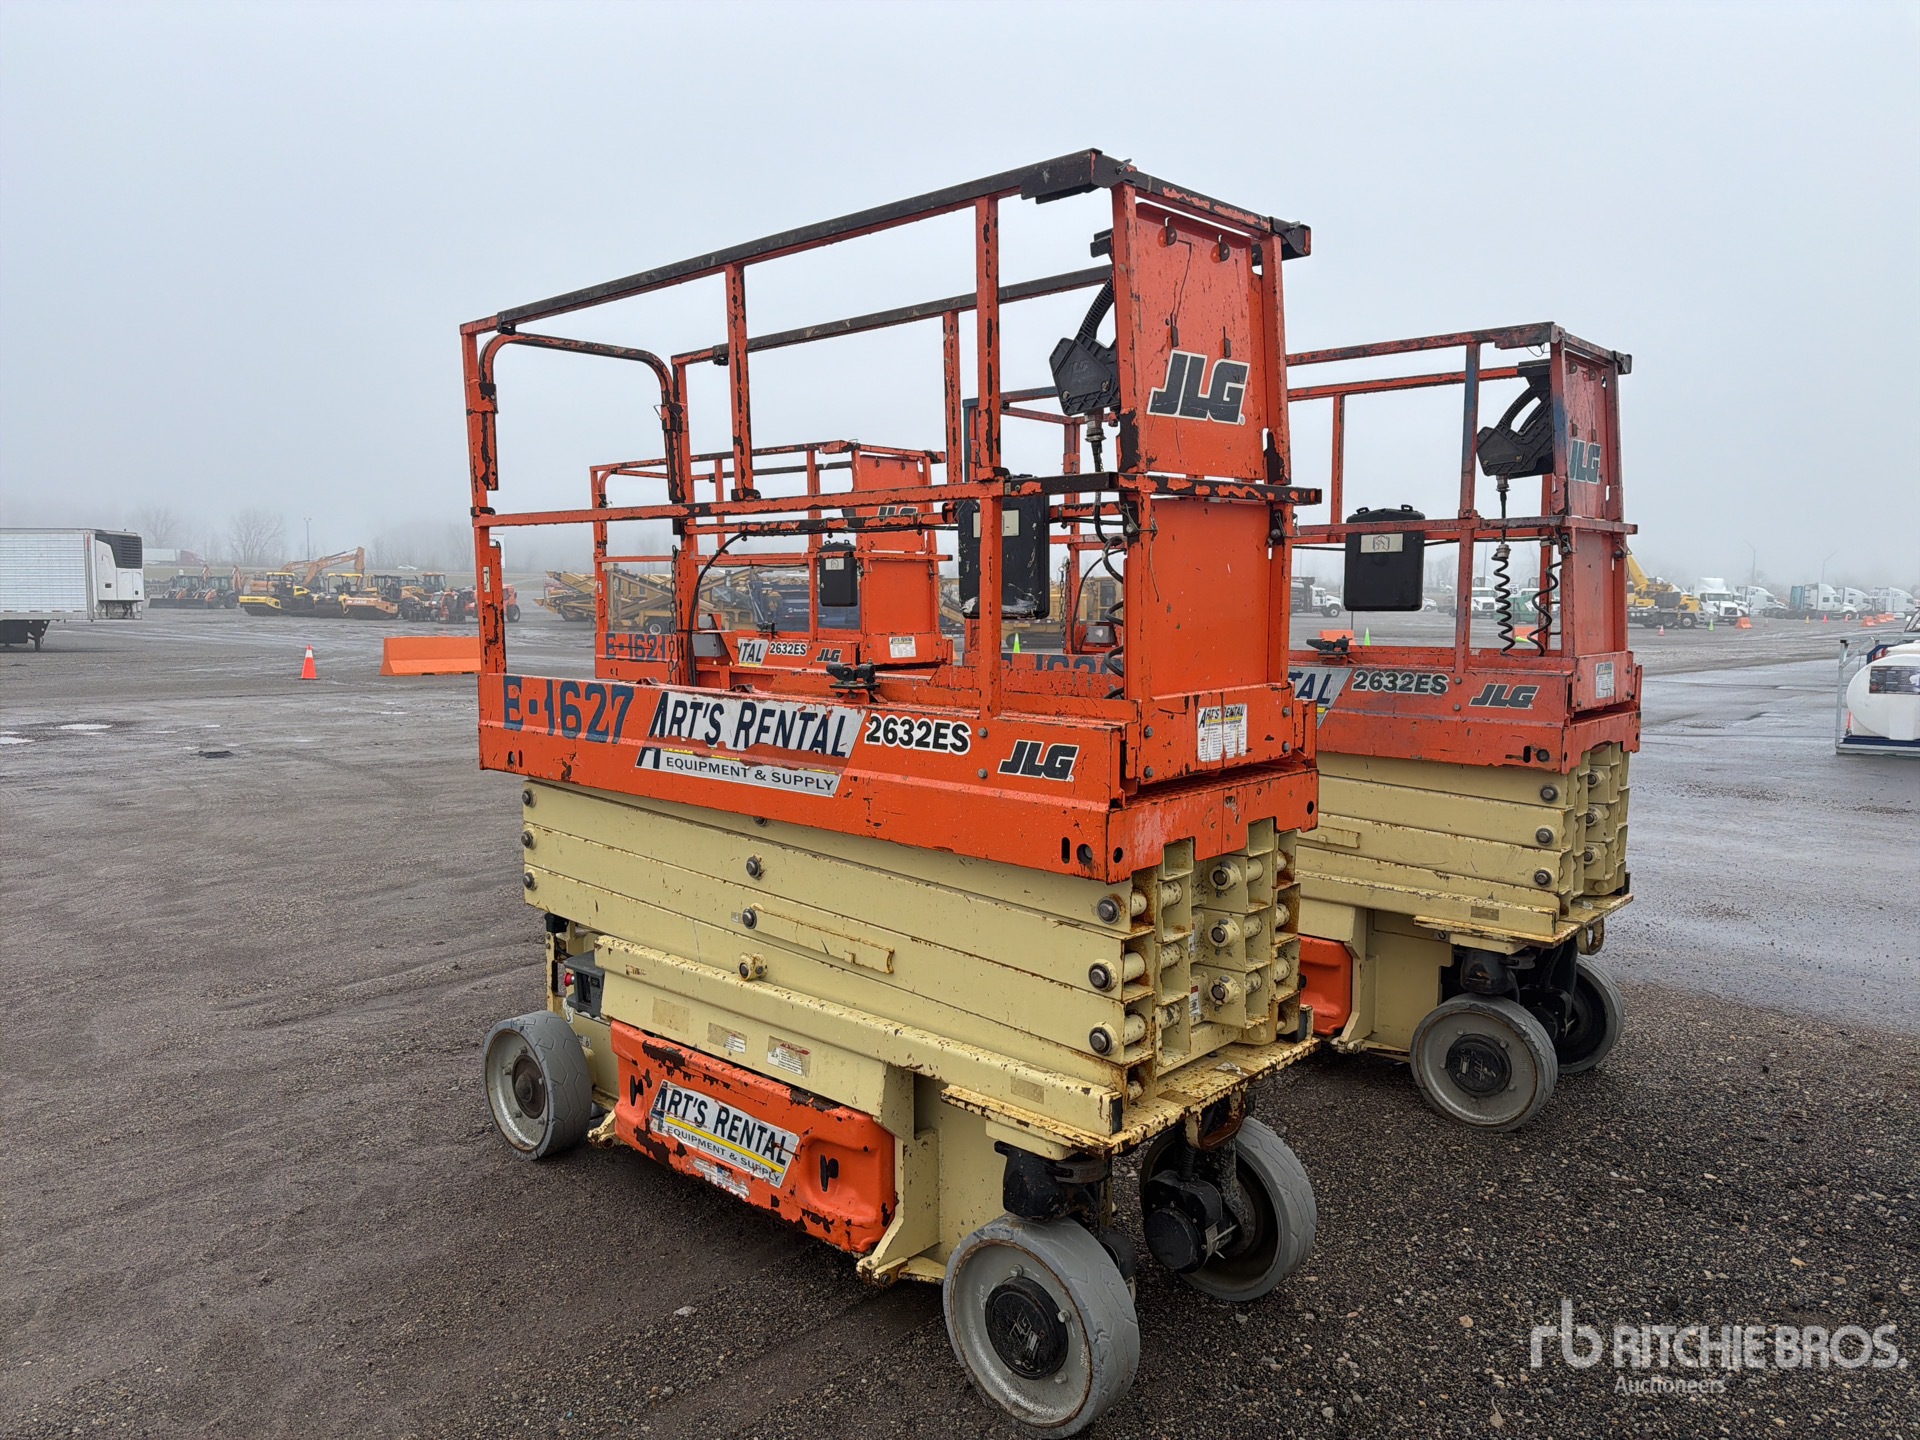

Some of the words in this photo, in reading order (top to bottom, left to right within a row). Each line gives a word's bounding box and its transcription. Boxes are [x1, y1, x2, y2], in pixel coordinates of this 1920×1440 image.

[1148, 350, 1249, 424] JLG
[1569, 439, 1601, 484] JLG
[606, 633, 666, 659] E-1621
[738, 642, 763, 663] TAL
[769, 642, 806, 656] 2632ES
[816, 648, 842, 662] JLG
[1351, 672, 1448, 694] 2632ES
[1470, 684, 1539, 708] JLG
[503, 675, 634, 744] E-1627
[732, 701, 848, 758] RENTAL
[866, 714, 971, 753] 2632ES
[666, 755, 750, 780] EQUIPMENT
[754, 768, 767, 781] &
[771, 771, 834, 791] SUPPLY
[999, 739, 1079, 780] JLG
[666, 1125, 726, 1156] EQUIPMENT
[729, 1151, 738, 1162] &
[740, 1156, 780, 1183] SUPPLY
[713, 1105, 788, 1167] RENTAL
